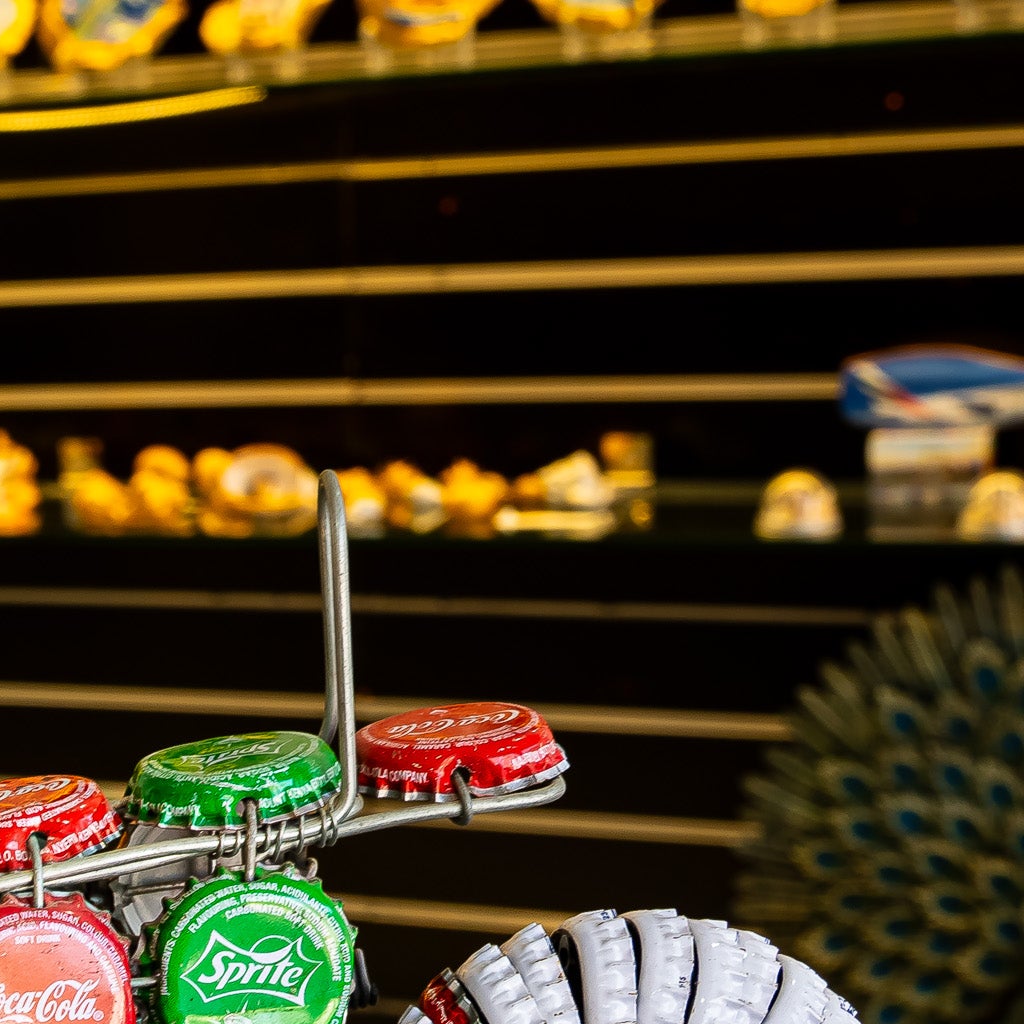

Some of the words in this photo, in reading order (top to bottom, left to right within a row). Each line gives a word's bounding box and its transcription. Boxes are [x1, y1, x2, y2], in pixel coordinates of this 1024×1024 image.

[20, 910, 50, 920] WATER,
[51, 911, 81, 928] SUGAR,
[198, 950, 304, 990] Sprite
[344, 964, 352, 982] AND
